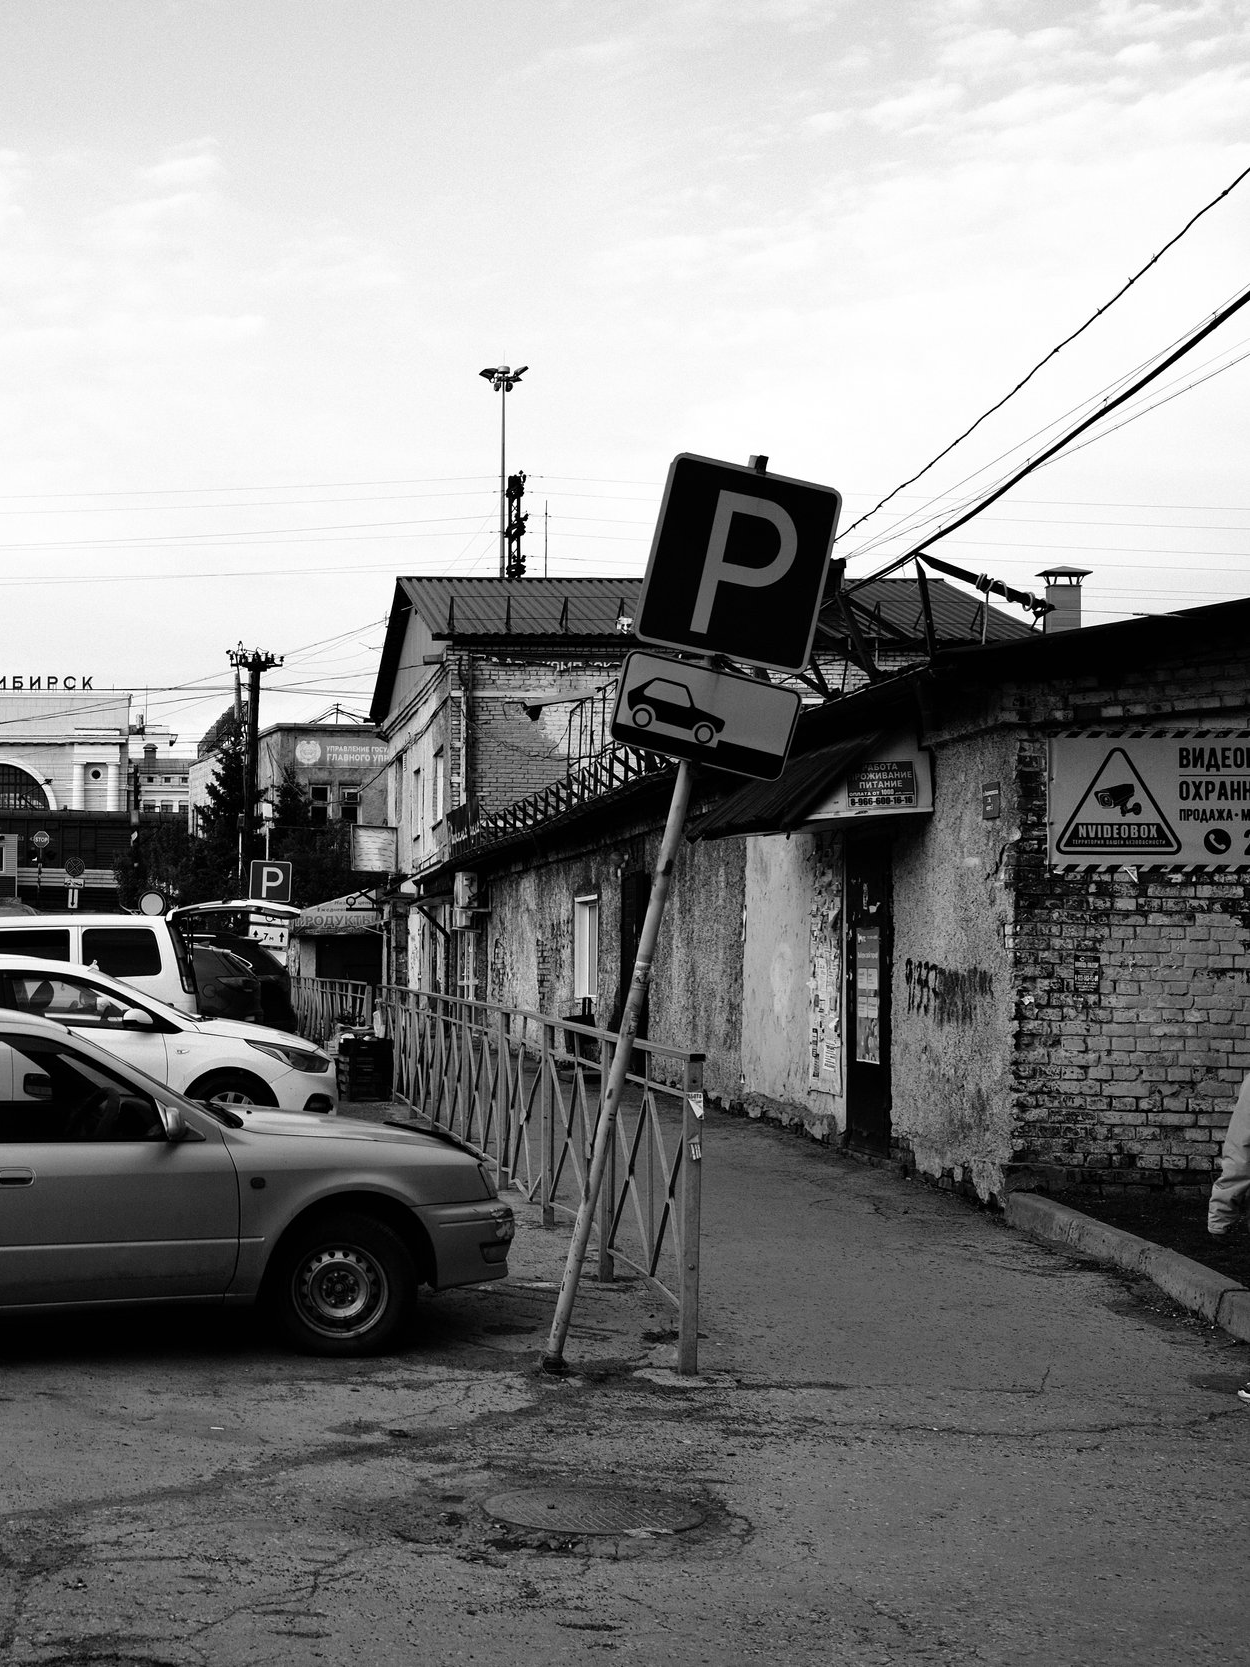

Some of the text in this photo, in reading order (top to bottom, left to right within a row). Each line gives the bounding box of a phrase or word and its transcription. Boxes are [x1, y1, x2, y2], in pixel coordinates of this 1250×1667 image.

[689, 489, 798, 634] P
[326, 745, 369, 753] УПРАВЛЕНИЕ
[859, 780, 903, 789] ПИТАНИЕ
[1179, 808, 1233, 823] ПРОДАЖА
[1078, 825, 1158, 838] NVIDEOBOX
[261, 866, 284, 898] P
[295, 915, 376, 928] ПРОДУКТЫ
[263, 932, 269, 940] 7
